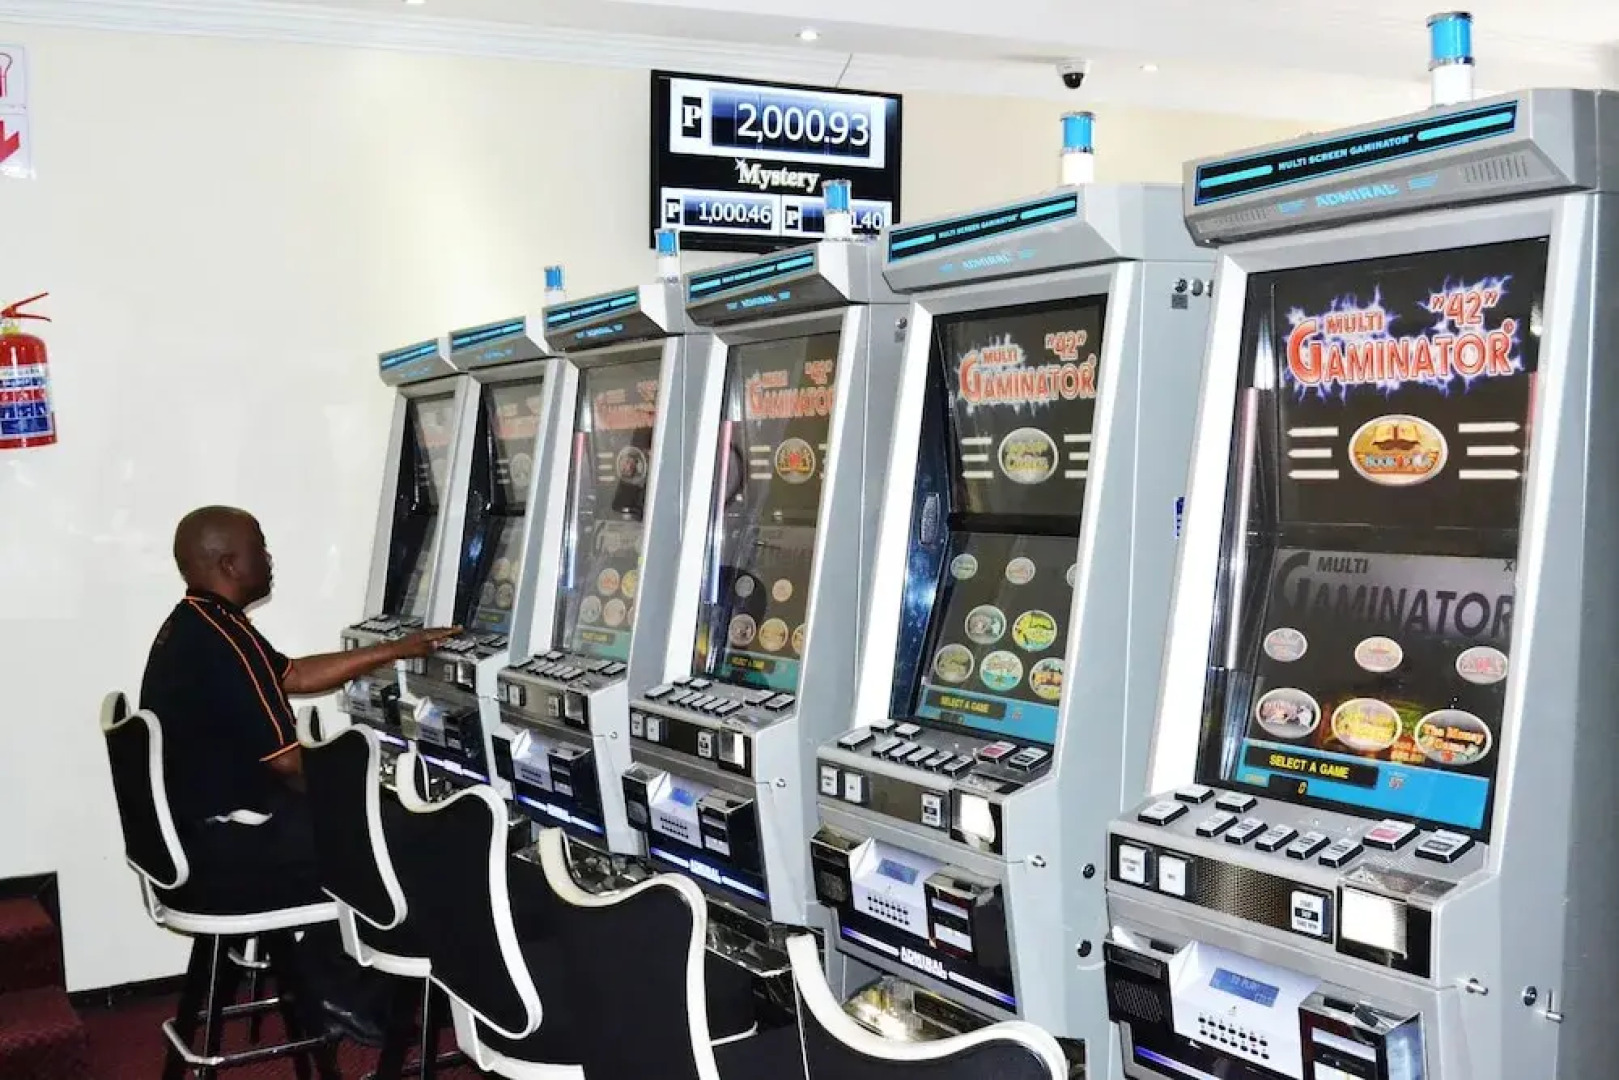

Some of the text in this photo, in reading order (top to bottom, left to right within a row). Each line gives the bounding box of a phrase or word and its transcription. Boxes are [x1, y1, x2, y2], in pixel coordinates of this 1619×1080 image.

[737, 102, 870, 147] 2,000.93
[1308, 149, 1348, 165] SCREEN
[737, 163, 820, 193] Mystery
[1315, 184, 1401, 208] ADMIRAL
[699, 202, 772, 224] 1,000.46
[1324, 310, 1385, 336] MULTI
[1316, 556, 1370, 574] MULTI
[1268, 753, 1350, 780] SELECT A GAME
